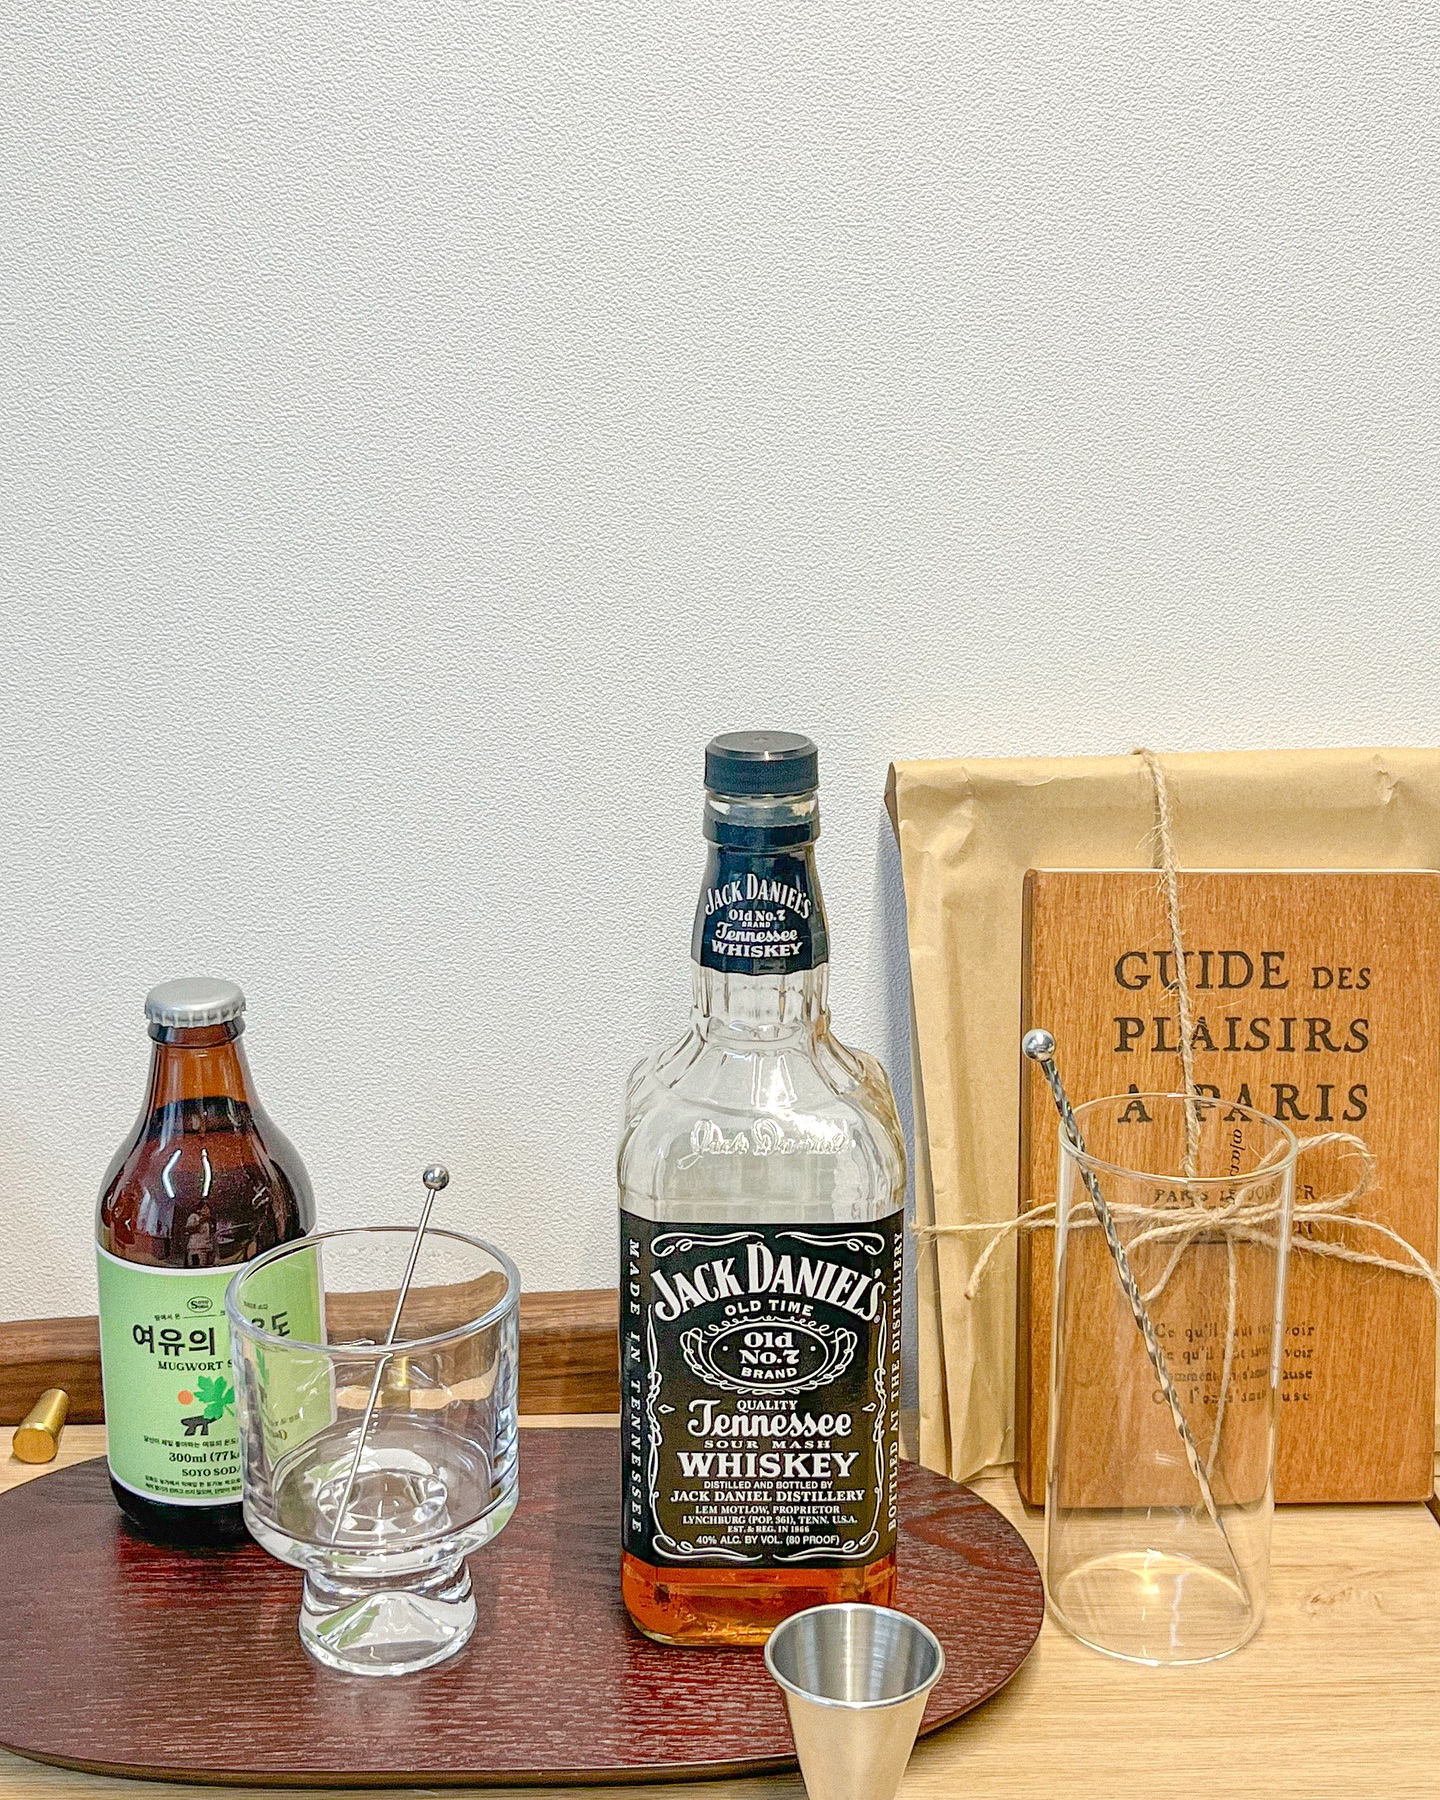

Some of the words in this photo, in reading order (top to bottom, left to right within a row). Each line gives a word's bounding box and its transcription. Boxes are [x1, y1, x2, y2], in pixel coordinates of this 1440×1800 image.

[704, 880, 743, 916] JACK
[745, 873, 812, 920] DANIEL'S
[728, 909, 753, 921] Old
[755, 909, 787, 922] No.7
[715, 921, 798, 943] Tennessee
[711, 939, 804, 959] WHISKEY
[1114, 950, 1290, 991] GUIDE
[1311, 966, 1371, 990] DES
[1113, 1017, 1370, 1053] PLAISIRS
[1117, 1083, 1152, 1124] A
[1193, 1083, 1368, 1123] PARIS
[1155, 1188, 1208, 1203] PARS
[629, 1239, 641, 1316] MADE
[650, 1257, 745, 1321] JACK
[746, 1242, 887, 1323] DANIEL'S
[891, 1232, 903, 1354] DISTILLERY
[724, 1301, 761, 1317] OLD
[768, 1299, 814, 1318] TIME
[132, 1324, 216, 1357] 여유의
[630, 1331, 641, 1363] IN
[743, 1331, 795, 1348] Old
[158, 1360, 224, 1371] MUGWORT
[738, 1349, 800, 1366] No.7
[741, 1366, 798, 1380] BRAND
[890, 1359, 900, 1402] THE
[736, 1400, 798, 1413] QUALITY
[687, 1399, 852, 1438] Tennessee
[703, 1439, 759, 1449] SOUR
[772, 1439, 831, 1449] MASH
[169, 1452, 207, 1463] 300ml
[630, 1380, 642, 1533] TENNESSEE
[677, 1452, 860, 1478] WHISKEY
[182, 1468, 211, 1477] SOYO
[704, 1480, 750, 1489] DISTILLED
[753, 1480, 773, 1489] AND
[776, 1480, 818, 1489] BOTTLED
[820, 1480, 833, 1489] BY
[888, 1441, 899, 1532] BOTTLED
[670, 1490, 710, 1502] JACK
[714, 1490, 772, 1502] DANIEL
[776, 1490, 865, 1502] DISTILLERY
[682, 1515, 746, 1525] LYNCHBURG
[748, 1515, 774, 1525] (POP.
[799, 1515, 830, 1525] TENN.
[832, 1515, 858, 1525] U.S.A.
[695, 1505, 718, 1514] LEM
[721, 1505, 770, 1516] MOTLOW,
[772, 1505, 840, 1514] PROPRIETOR
[696, 1535, 717, 1545] 40%
[720, 1535, 742, 1545] ALC.
[744, 1535, 759, 1545] BY
[760, 1535, 783, 1545] VOL.
[786, 1535, 800, 1546] (80
[803, 1535, 840, 1546] PROOF)
